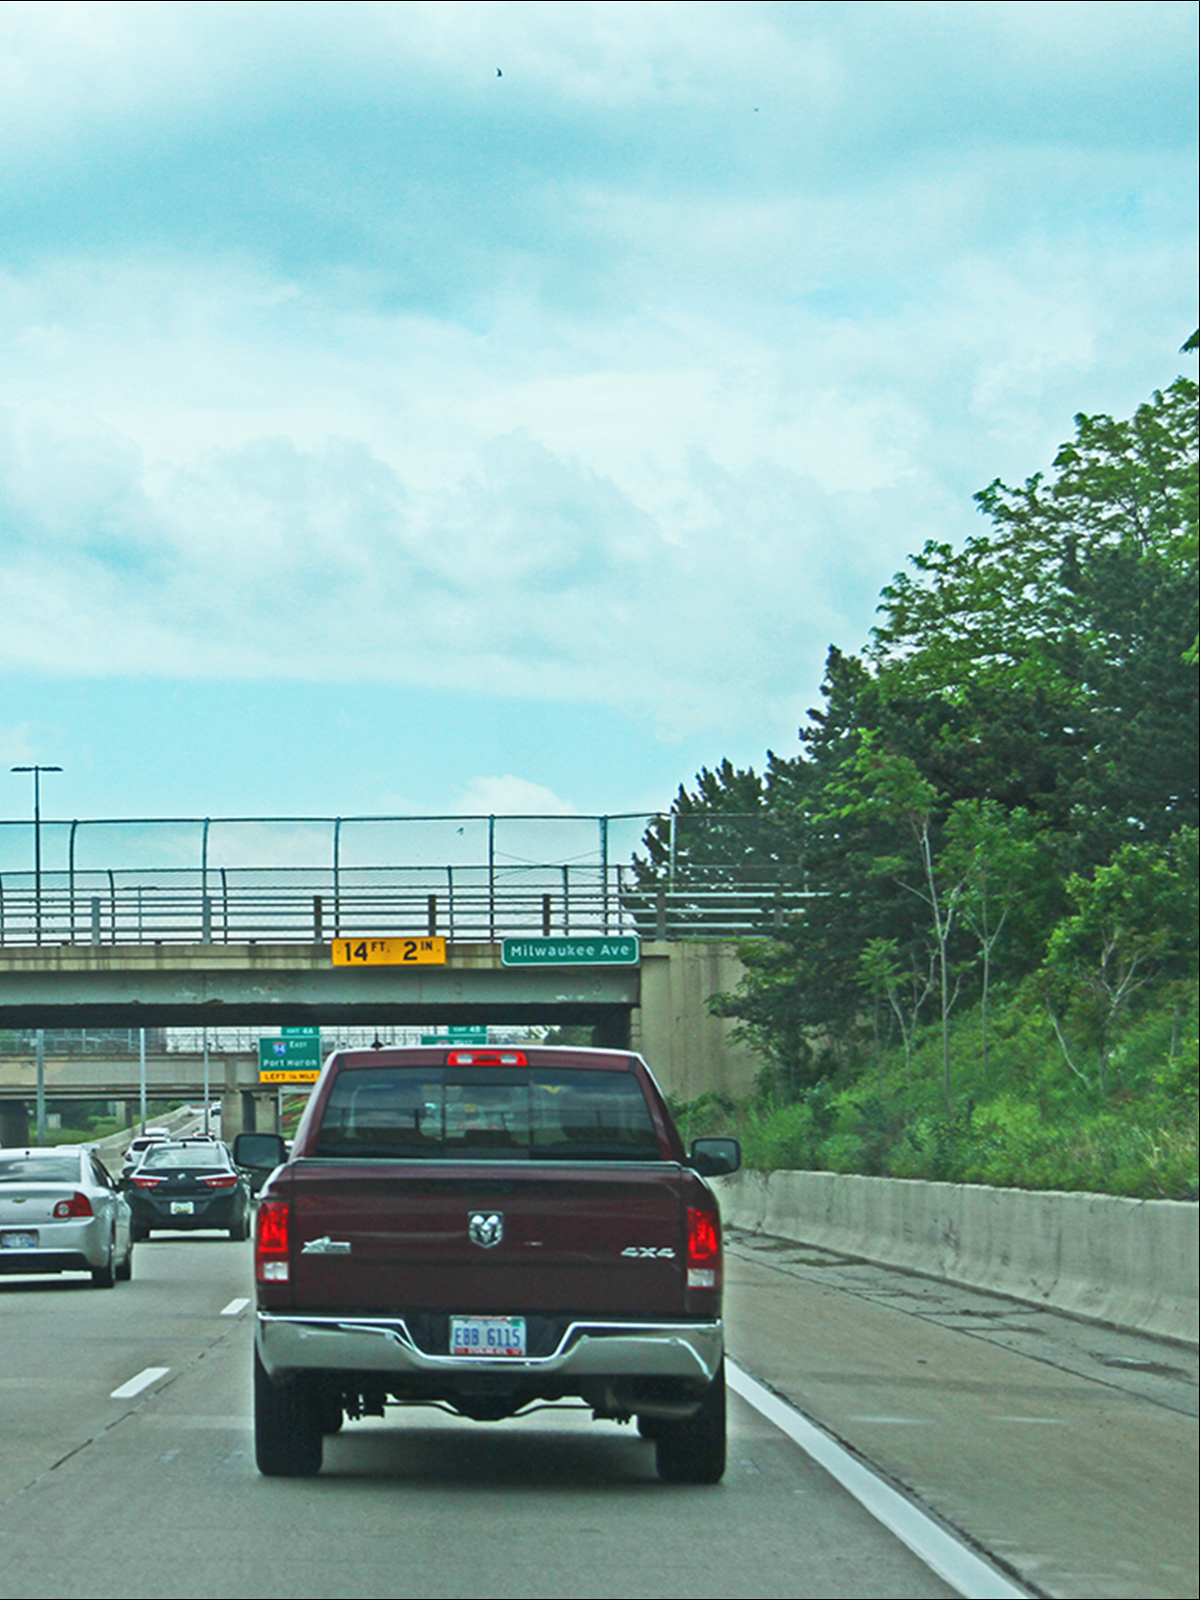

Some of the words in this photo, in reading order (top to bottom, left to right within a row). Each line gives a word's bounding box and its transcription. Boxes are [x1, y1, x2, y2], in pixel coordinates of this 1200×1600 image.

[344, 942, 368, 962] 14
[403, 941, 418, 961] 2
[511, 945, 595, 957] Milwaukee
[600, 945, 629, 956] Ave
[263, 1059, 285, 1067] Port
[286, 1059, 317, 1067] Huron
[454, 1327, 480, 1346] EBB
[486, 1327, 521, 1347] 6115
